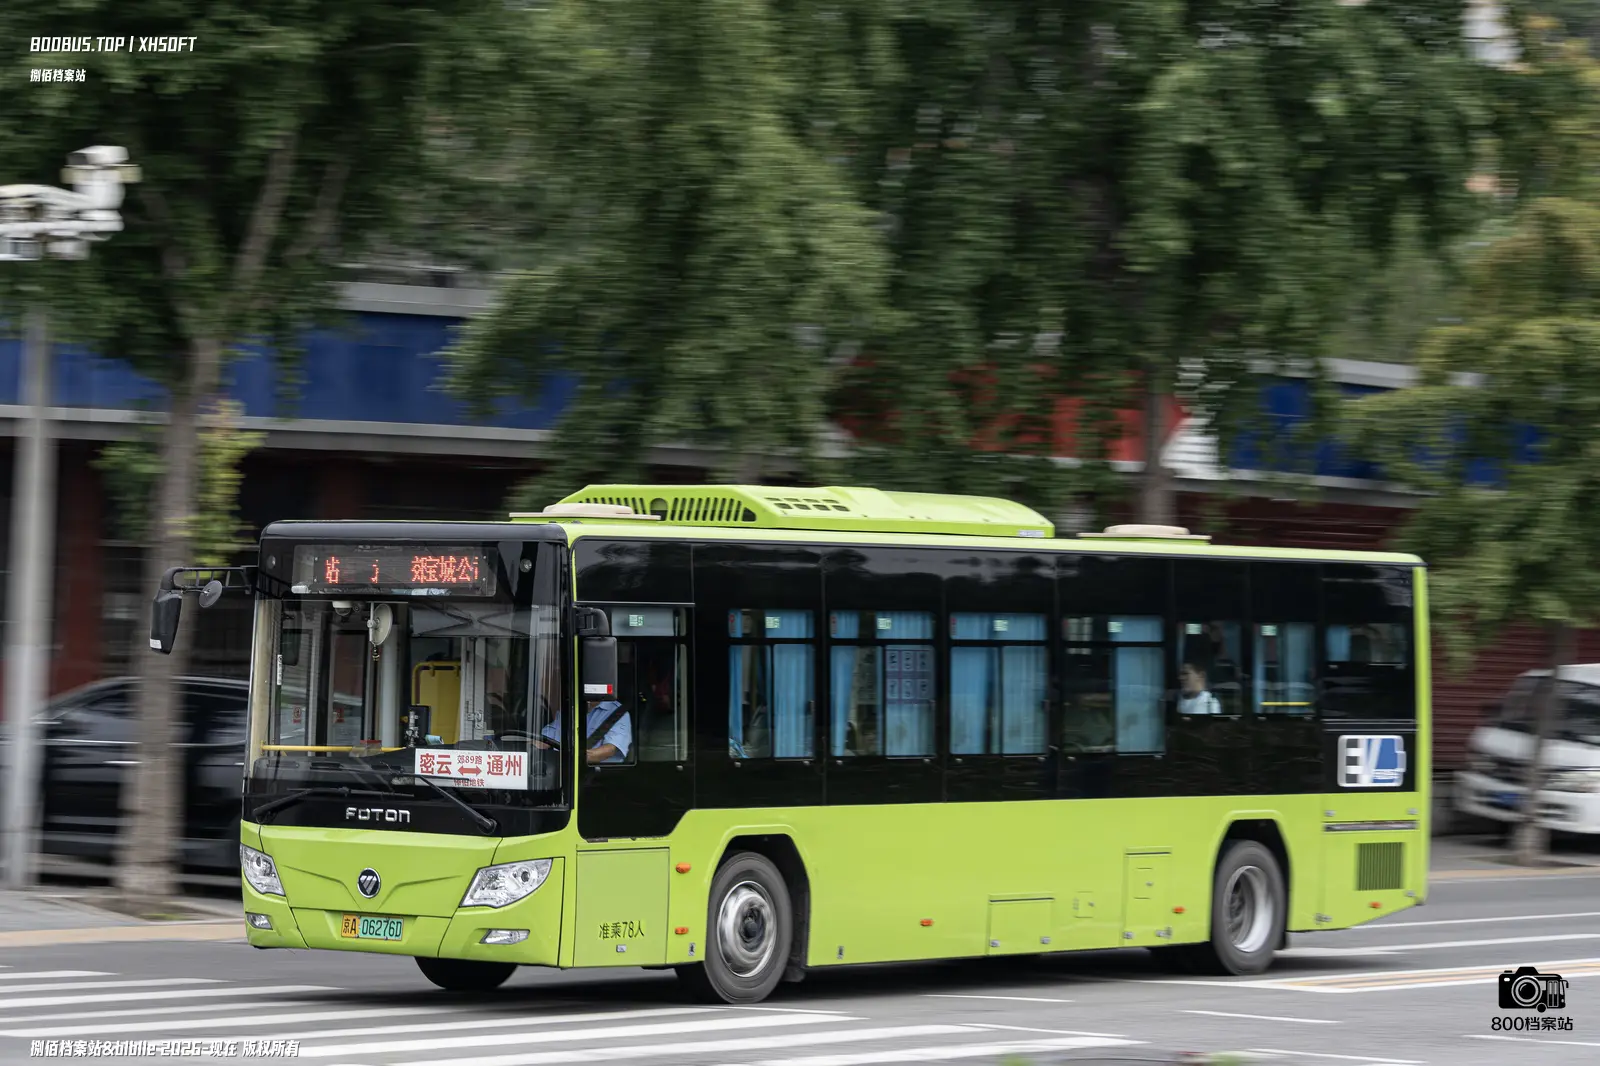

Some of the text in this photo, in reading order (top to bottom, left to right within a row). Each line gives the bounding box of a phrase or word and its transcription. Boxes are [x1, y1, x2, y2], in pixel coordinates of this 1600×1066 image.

[420, 753, 452, 775] 密云
[457, 755, 483, 765] 郊89路
[486, 754, 523, 776] 通州
[345, 806, 411, 824] FOTON
[598, 920, 645, 940] 准乘78人
